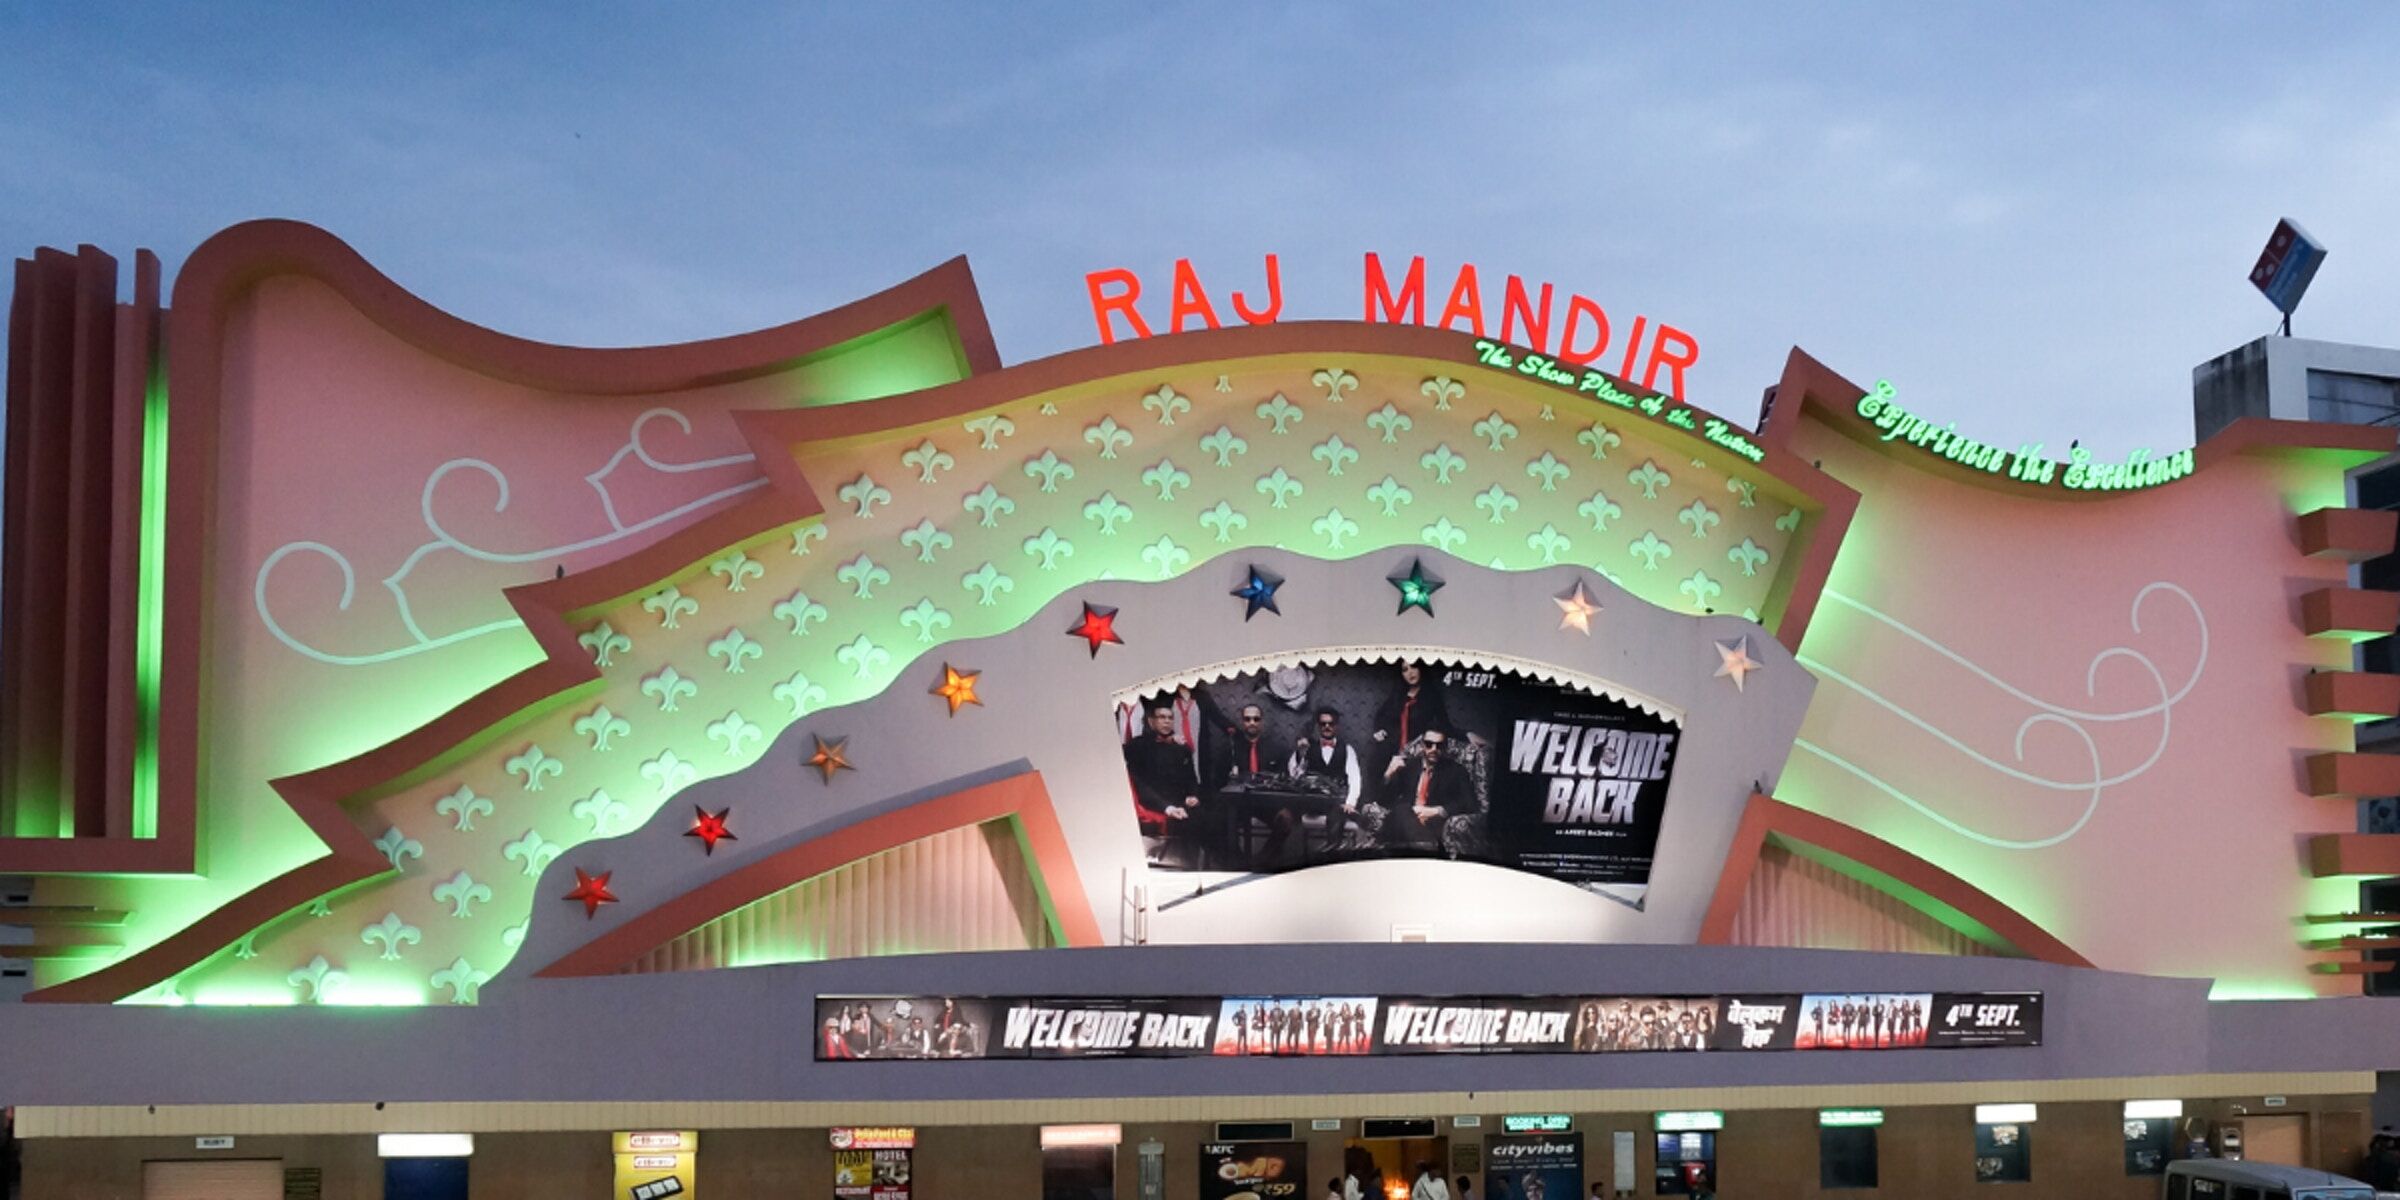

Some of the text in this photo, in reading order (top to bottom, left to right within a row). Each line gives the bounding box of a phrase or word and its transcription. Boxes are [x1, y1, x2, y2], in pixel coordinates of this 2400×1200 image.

[1086, 252, 1699, 402] RAJ MANDIR
[1475, 340, 1764, 462] The Show Place of the Nation
[1857, 379, 2194, 490] Experience the Excellence
[1465, 672, 1498, 689] SEPT.
[1509, 719, 1674, 781] WELCOME
[1542, 776, 1643, 824] BACK
[1003, 1006, 1212, 1049] WELCOME BACK
[1383, 1004, 1571, 1046] WELCOME BACK
[1727, 999, 1787, 1025] वेलकम
[1975, 1004, 2021, 1027] SEPT.
[875, 1149, 908, 1161] HOTEL
[1492, 1142, 1575, 1158] cityvibes
